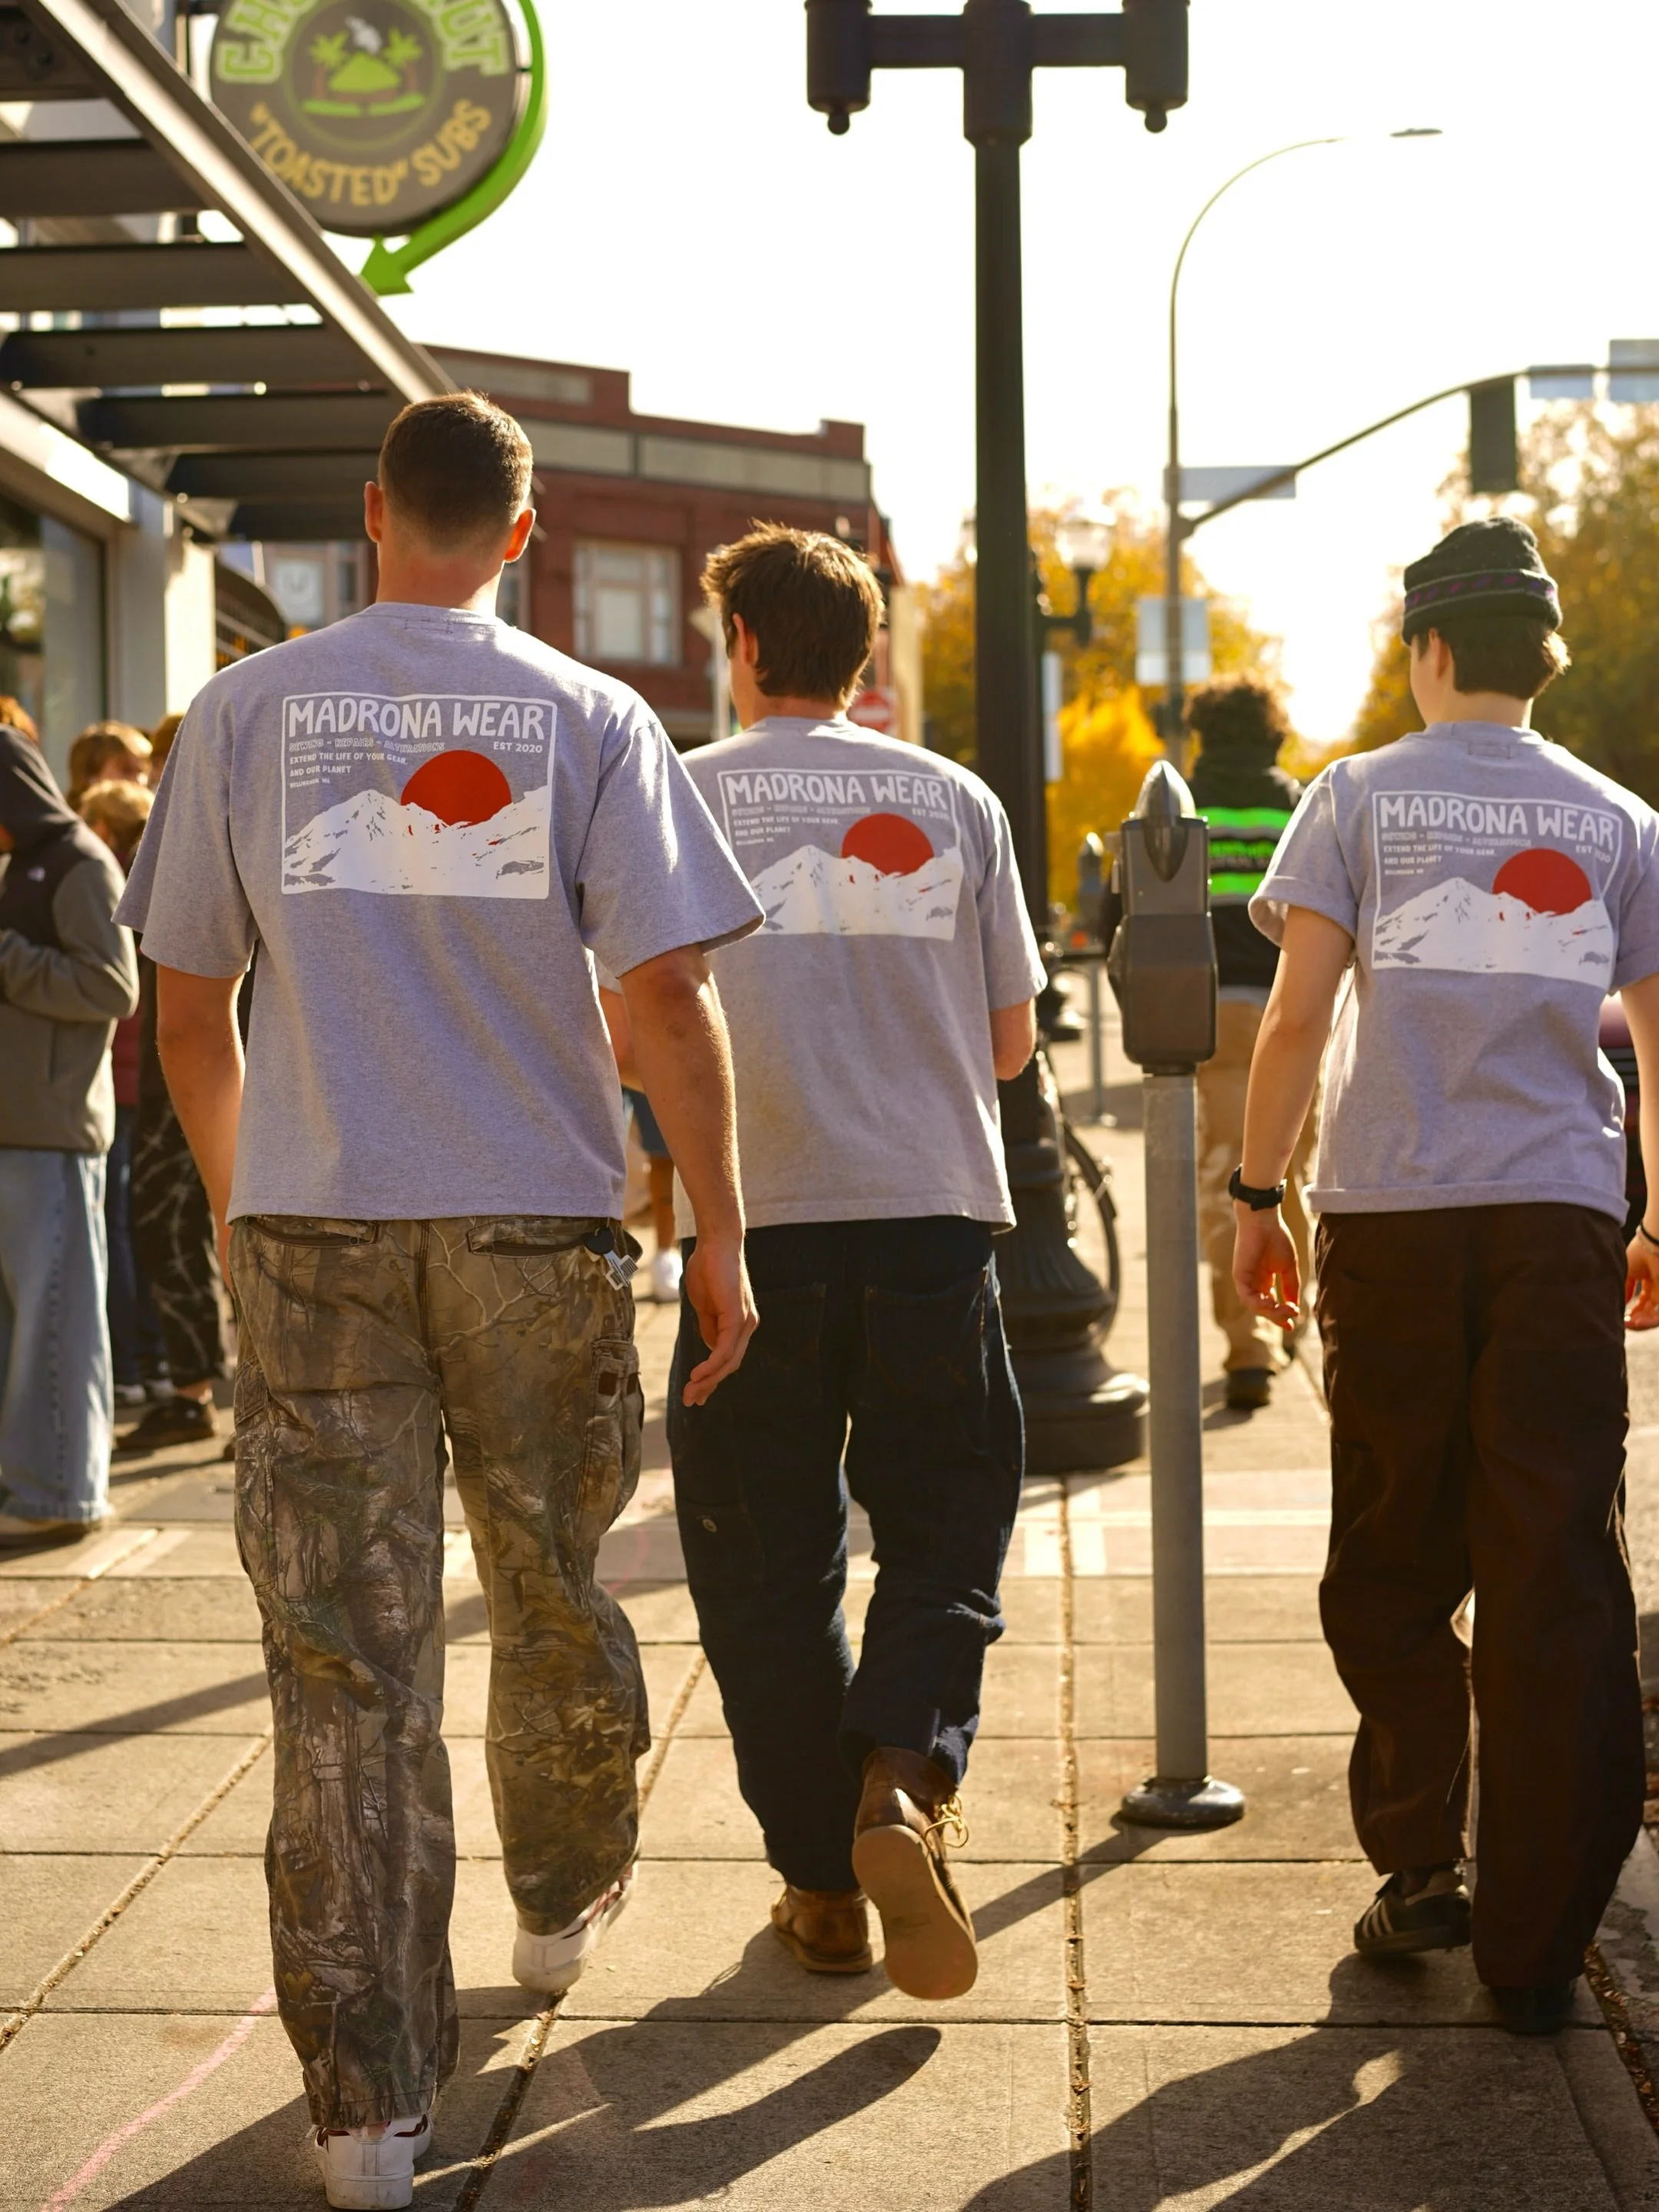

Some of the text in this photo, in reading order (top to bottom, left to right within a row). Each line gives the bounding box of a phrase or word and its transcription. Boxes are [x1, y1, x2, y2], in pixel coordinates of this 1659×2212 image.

[415, 0, 508, 76] UT
[410, 98, 492, 187] SUBS
[289, 698, 545, 740] MADRONA WEAR
[289, 739, 324, 752] SEWING
[335, 737, 374, 747] REPAIRS
[383, 740, 445, 753] ALTERATIONS
[290, 753, 317, 765] EXTEND
[319, 752, 334, 760] THE
[336, 752, 352, 760] LIFE
[353, 752, 364, 760] OF
[366, 752, 385, 760] YOUR
[494, 741, 543, 753] EST 2020
[290, 765, 351, 777] AND OUR PLANET
[725, 773, 948, 811] MADRONA WEAR
[1379, 796, 1614, 853] MADRONA WEAR
[1575, 844, 1593, 854] EST
